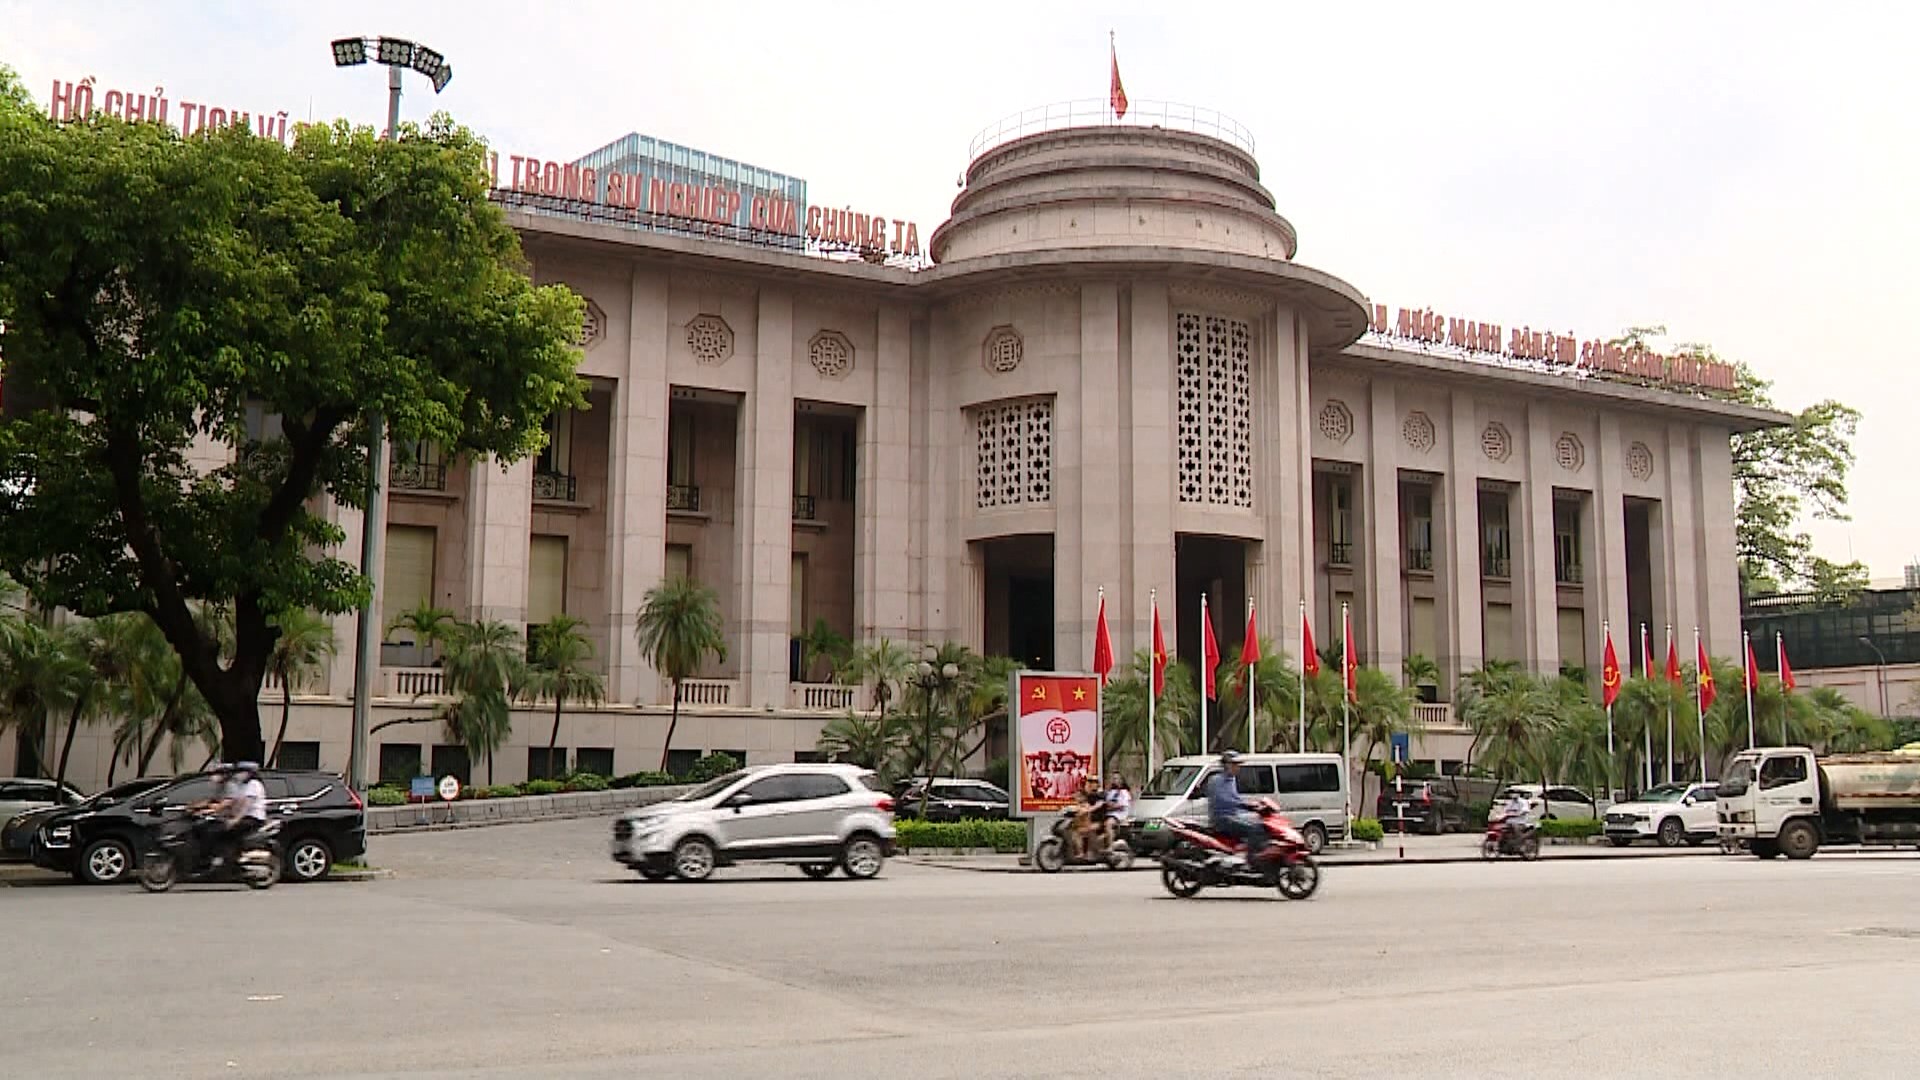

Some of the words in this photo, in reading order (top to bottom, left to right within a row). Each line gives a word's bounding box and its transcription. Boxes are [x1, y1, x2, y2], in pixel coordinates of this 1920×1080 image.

[510, 154, 597, 203] TRONG
[752, 189, 798, 237] CỦA
[806, 204, 887, 251] CHÚNG
[892, 218, 920, 257] TA
